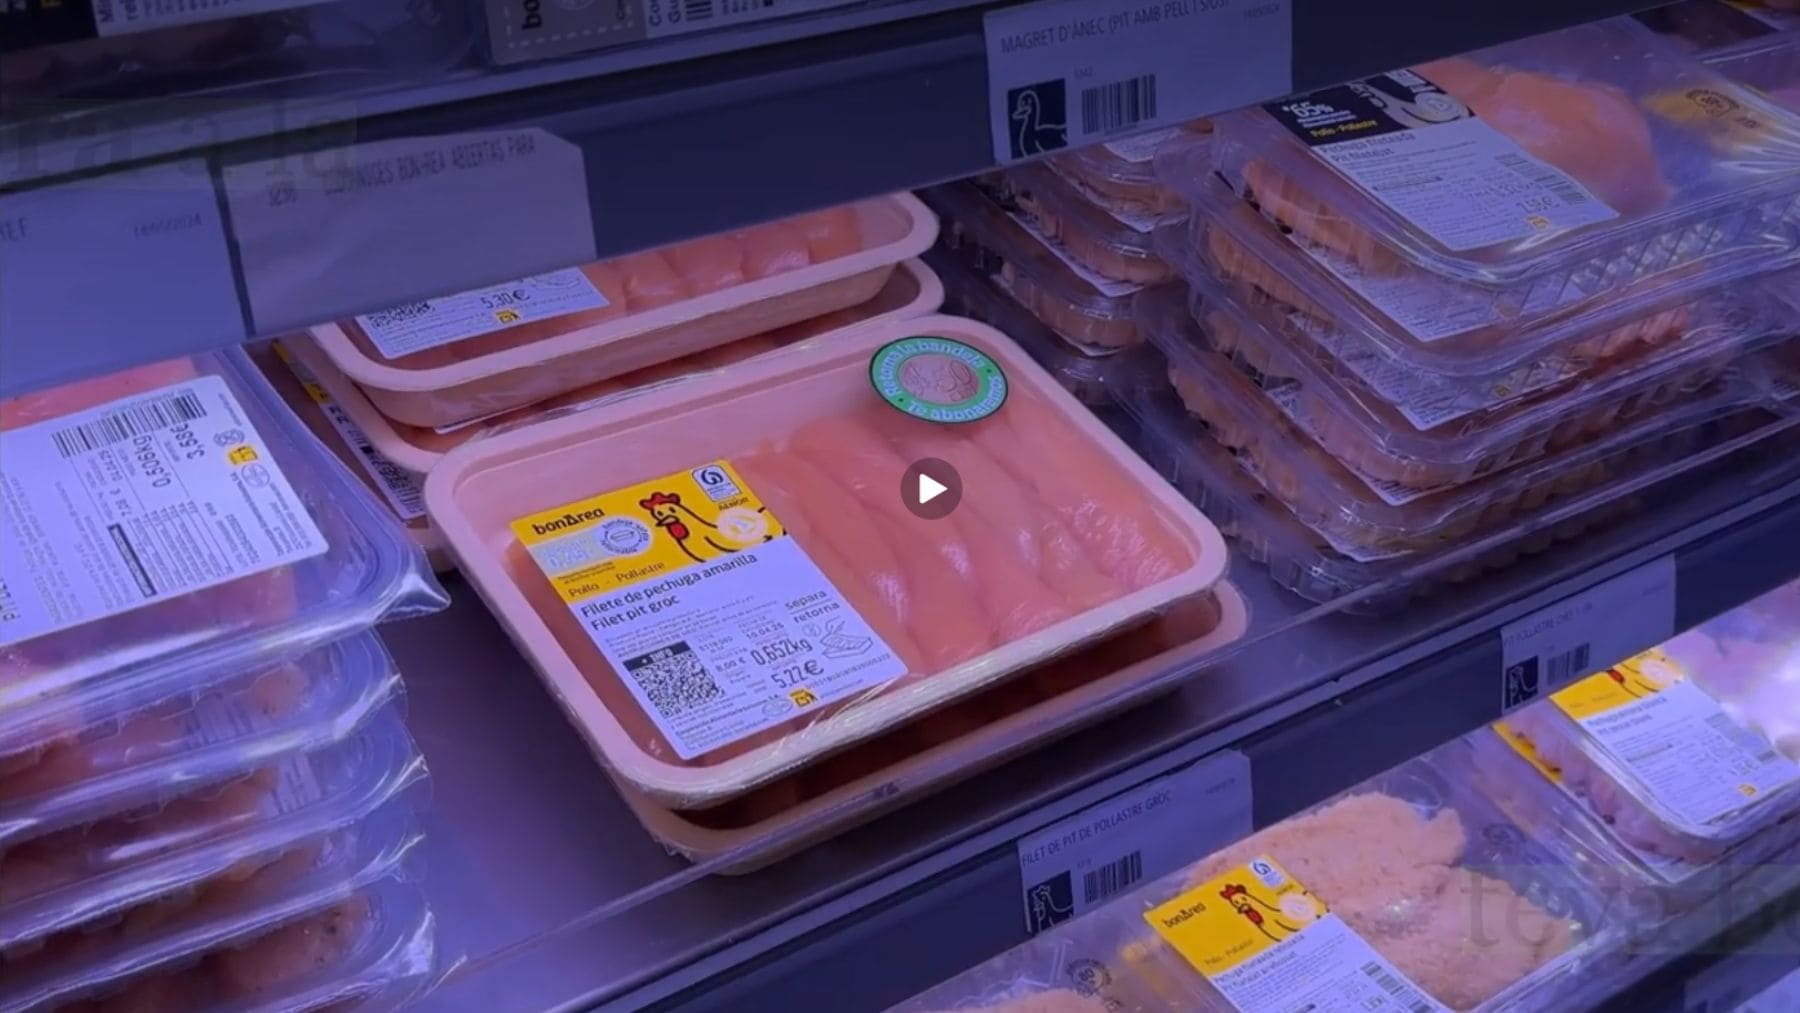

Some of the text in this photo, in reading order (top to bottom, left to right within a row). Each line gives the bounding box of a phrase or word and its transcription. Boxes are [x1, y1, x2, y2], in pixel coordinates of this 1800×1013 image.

[1001, 28, 1055, 53] MAGRET
[1108, 12, 1129, 35] (PIT
[1133, 5, 1161, 25] AMB
[1164, 1, 1190, 19] PELL
[568, 581, 600, 598] Pollo
[616, 561, 666, 583] Pollastre
[580, 553, 759, 618] Filete de pechuga amarilla
[589, 594, 681, 632] Filet pit groc
[783, 588, 828, 611] separa
[792, 600, 842, 625] retorna
[750, 637, 814, 668] 0,652kg
[770, 658, 824, 690] 5,22€
[1021, 788, 1171, 867] FILET DE PIT DE POLLASTRE GROC
